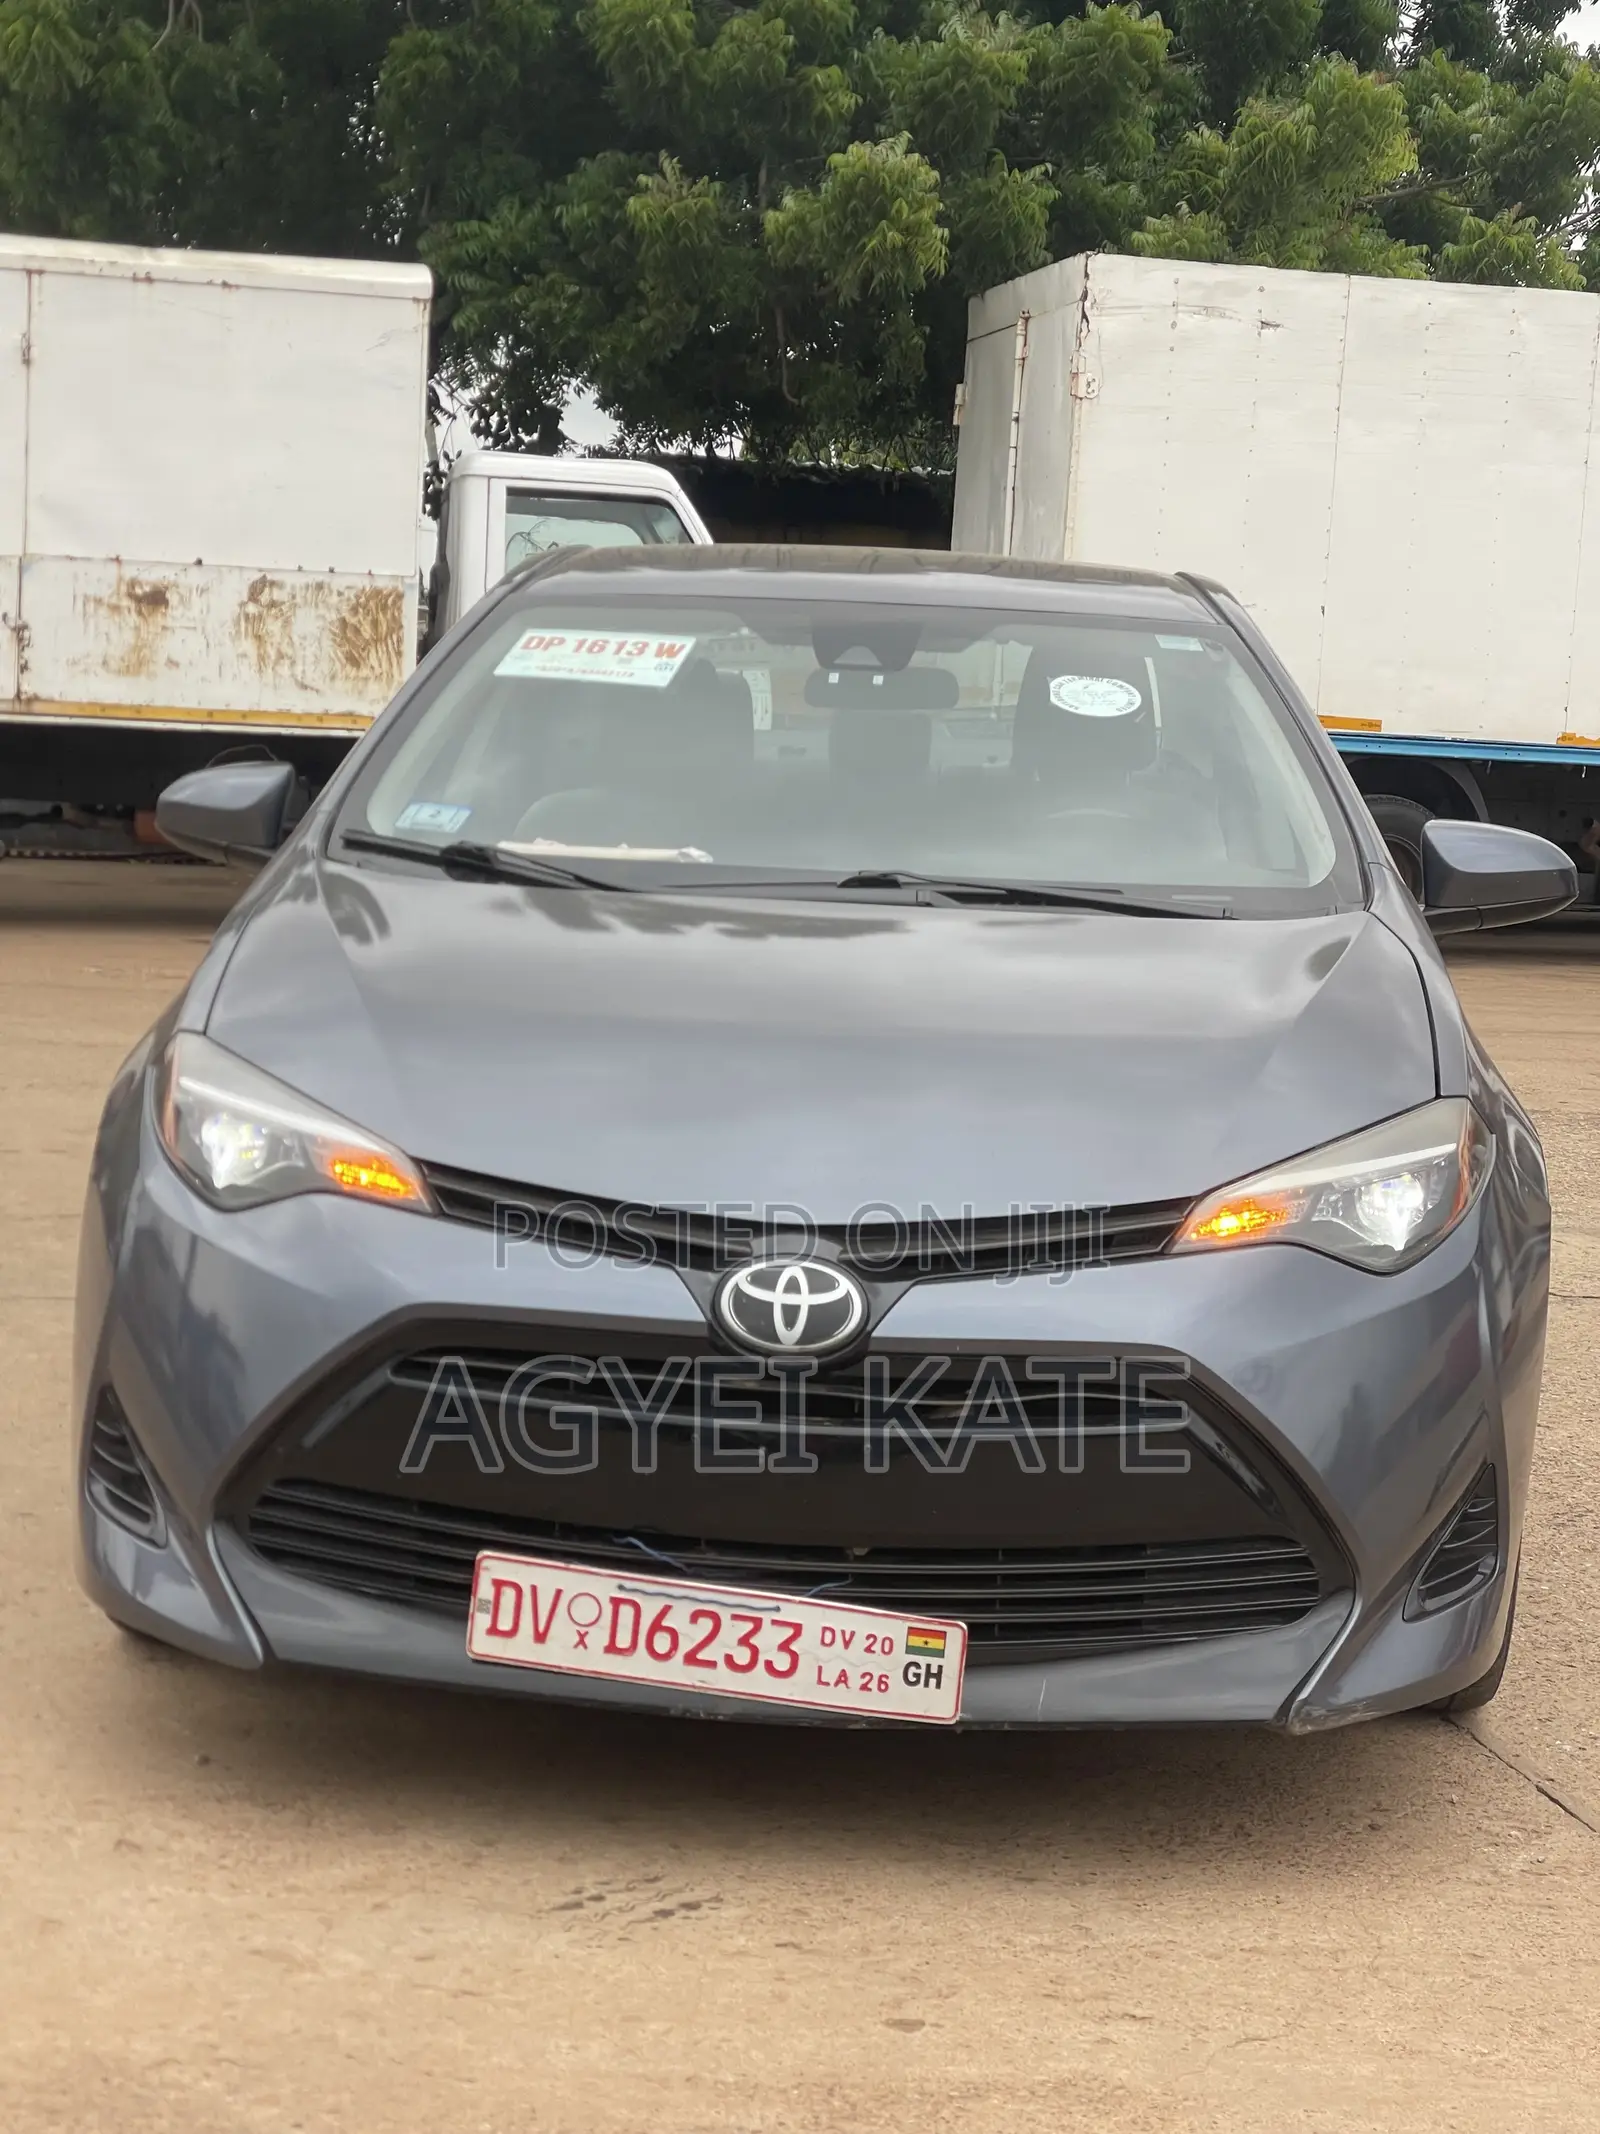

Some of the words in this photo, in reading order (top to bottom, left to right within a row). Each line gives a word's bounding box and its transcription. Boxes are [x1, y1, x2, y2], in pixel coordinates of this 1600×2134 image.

[520, 635, 567, 652] DP
[572, 638, 650, 656] 1613
[654, 642, 687, 658] W
[485, 1578, 564, 1644] DV
[603, 1595, 803, 1680] D6233
[820, 1626, 856, 1650] DV
[863, 1633, 894, 1656] 20
[816, 1665, 851, 1689] LA
[859, 1671, 890, 1693] 26
[902, 1661, 944, 1690] GH
